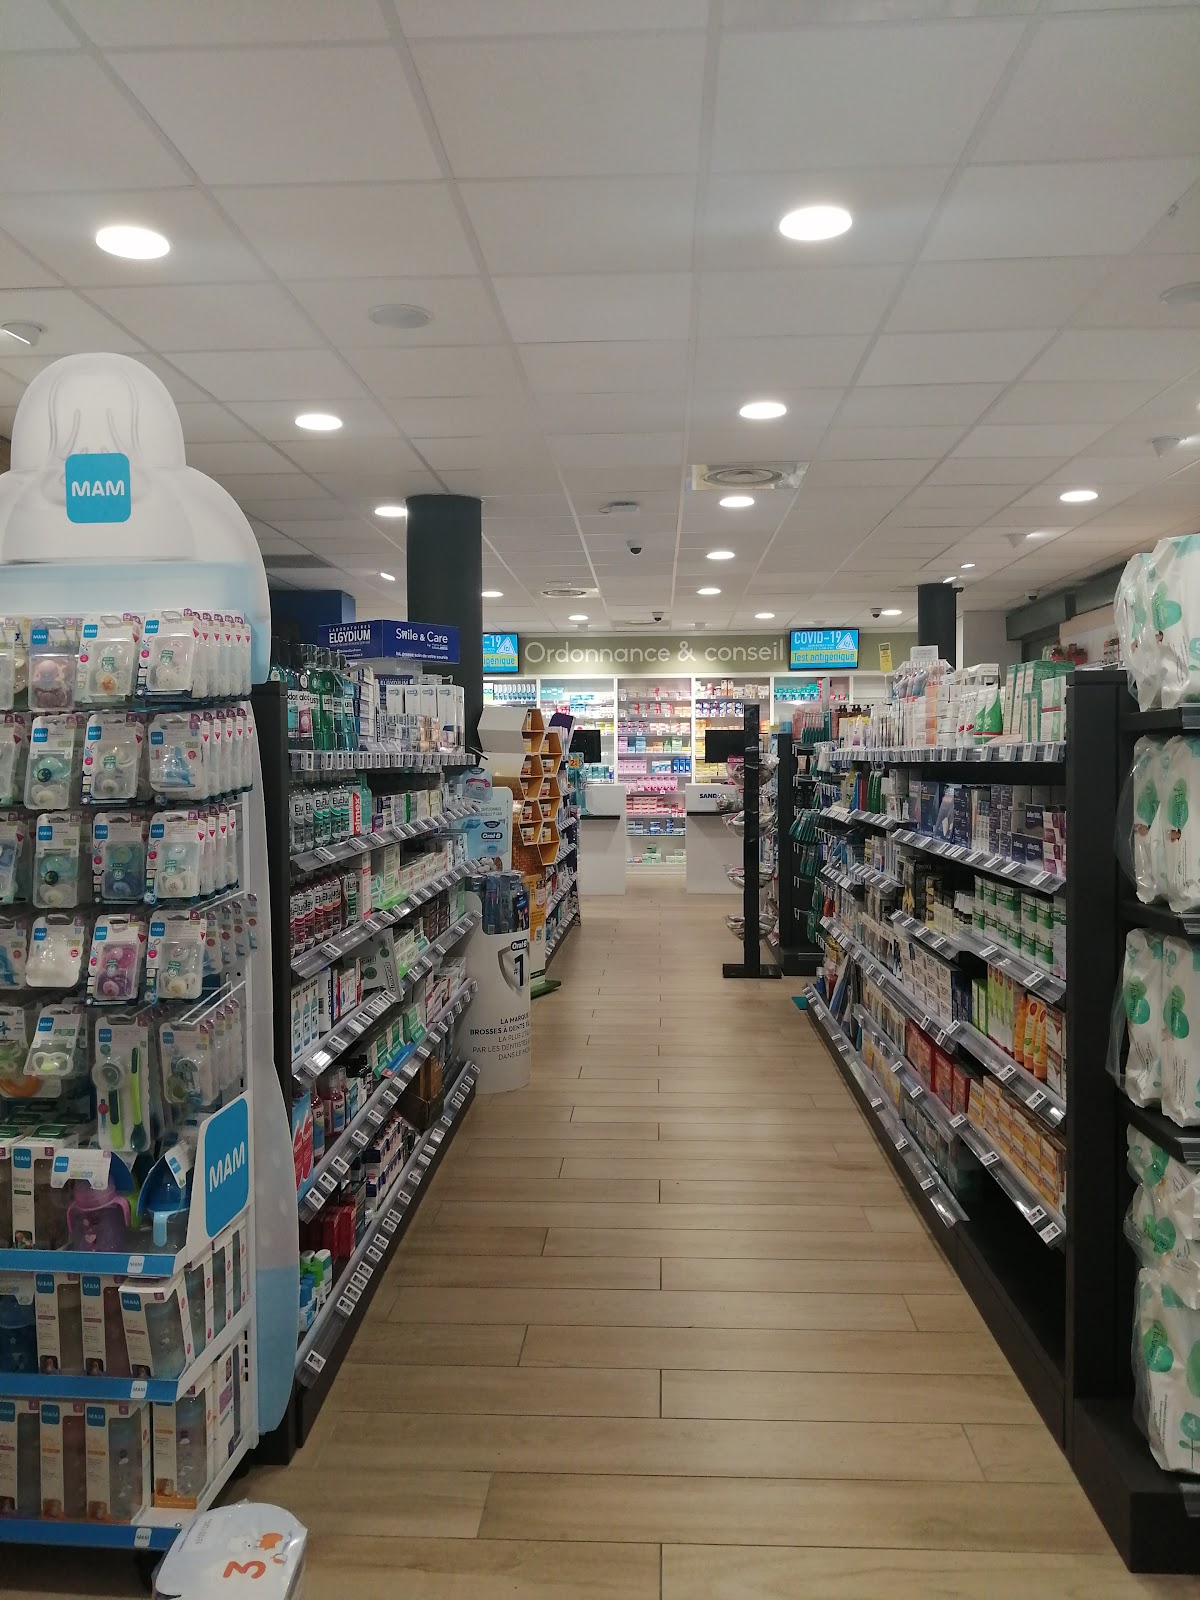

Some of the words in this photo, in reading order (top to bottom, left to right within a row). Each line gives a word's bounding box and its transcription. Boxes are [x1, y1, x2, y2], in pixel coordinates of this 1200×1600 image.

[71, 480, 125, 498] MAM
[329, 624, 371, 633] LABORATOIRES
[329, 629, 371, 644] ELGYDIUM
[395, 628, 418, 641] Smile
[419, 633, 426, 642] &
[426, 631, 449, 644] Care
[794, 631, 842, 645] COVID-19
[525, 641, 670, 664] Ordonnance
[678, 640, 696, 662] &
[705, 638, 785, 662] conseil
[794, 652, 809, 662] Test
[810, 651, 856, 663] antigénique
[511, 939, 528, 949] Oral-B
[510, 1013, 529, 1023] MARQUE
[470, 1028, 502, 1036] BROSSES
[509, 1022, 525, 1032] DENTS
[498, 1035, 507, 1043] LA
[508, 1032, 522, 1042] PLUS
[472, 1045, 488, 1053] PAR
[488, 1045, 501, 1053] LES
[502, 1040, 527, 1051] DENTISTES
[498, 1051, 516, 1061] DANS
[209, 1141, 245, 1192] MAM
[123, 1298, 140, 1306] MAM
[1187, 1416, 1198, 1433] 4
[223, 1561, 267, 1579] 3
